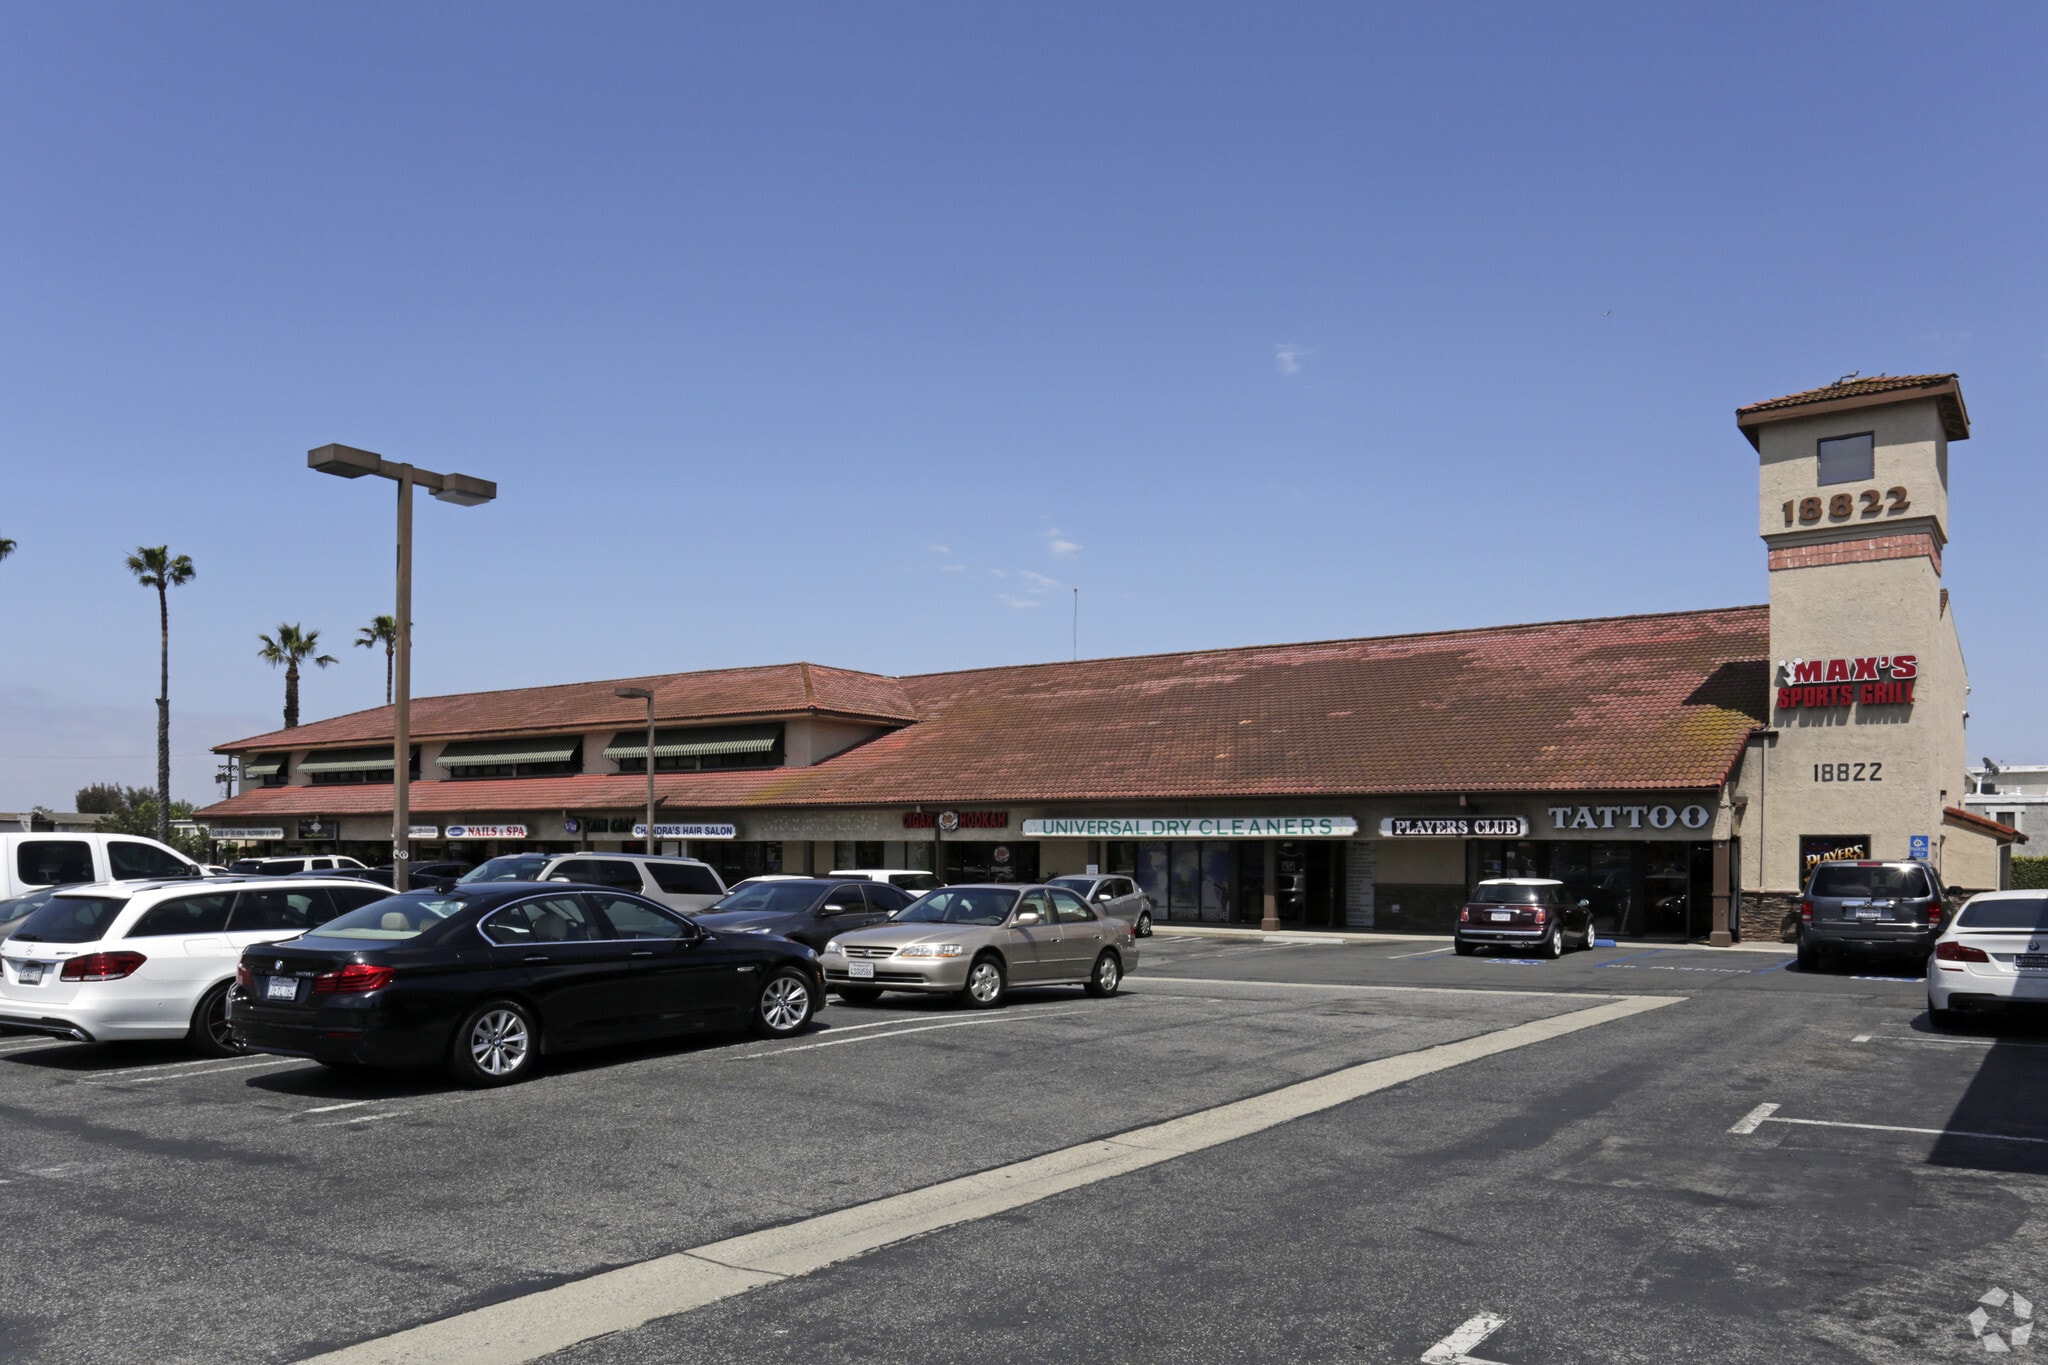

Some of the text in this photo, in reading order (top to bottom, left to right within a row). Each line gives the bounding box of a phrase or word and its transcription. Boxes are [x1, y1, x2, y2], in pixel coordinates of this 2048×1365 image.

[1782, 486, 1911, 523] 18822
[1793, 654, 1918, 684] MAX'S
[1777, 681, 1915, 709] SPORTS GRILL
[1814, 762, 1882, 782] 18822
[902, 812, 1007, 828] CIGAR HOOKAH
[1042, 818, 1332, 835] UNIVERSAL DRY CLEANERS
[1395, 818, 1519, 835] PLAYERS CLUB
[1548, 805, 1710, 830] TATTOO
[467, 826, 497, 836] NAILS
[506, 826, 525, 836] SPA
[635, 825, 681, 835] CHNDRA'S
[683, 826, 702, 835] HAIR
[705, 826, 733, 836] SALON
[1805, 844, 1865, 868] PLAYERS
